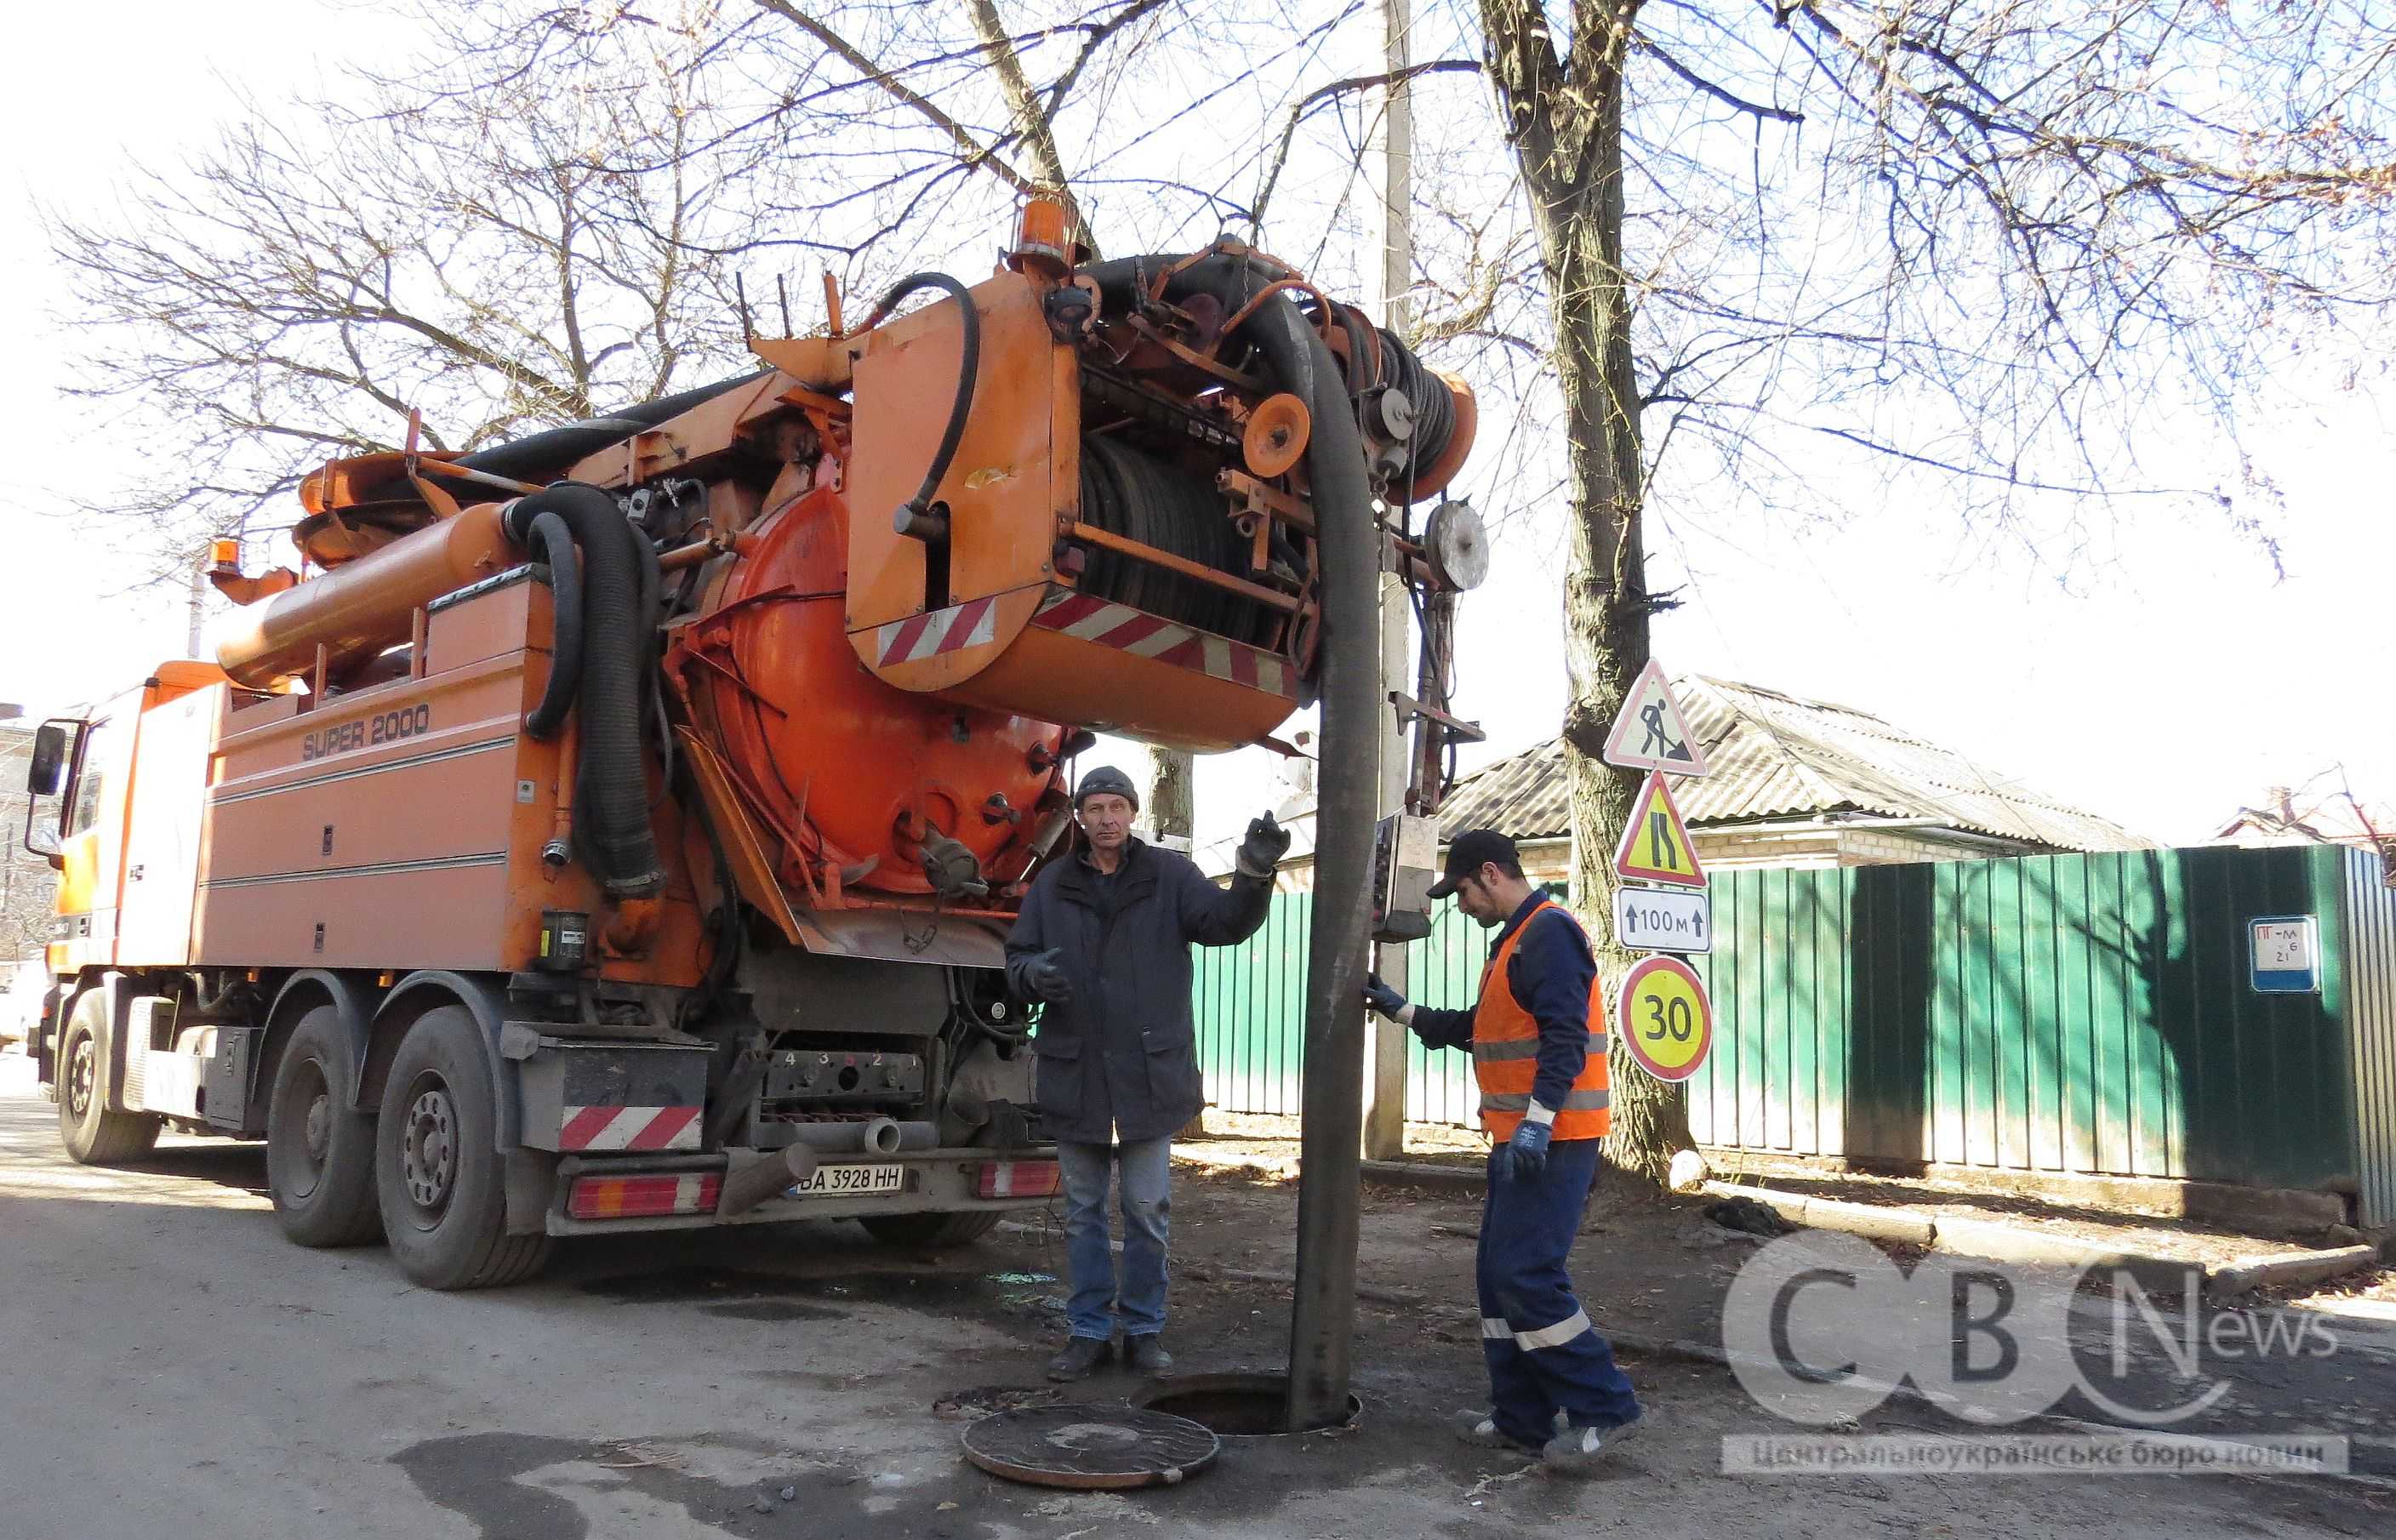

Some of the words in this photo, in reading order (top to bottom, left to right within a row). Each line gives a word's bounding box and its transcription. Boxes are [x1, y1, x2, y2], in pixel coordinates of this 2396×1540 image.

[303, 721, 364, 761] SUPER
[371, 704, 430, 744] 2000
[2276, 951, 2290, 962] 21
[1644, 994, 1692, 1042] 30
[784, 1052, 796, 1065] 4
[819, 1052, 829, 1064] 3
[873, 1054, 881, 1065] 2
[912, 1055, 917, 1066] 1
[831, 1169, 871, 1189] 3928
[875, 1167, 899, 1188] HH
